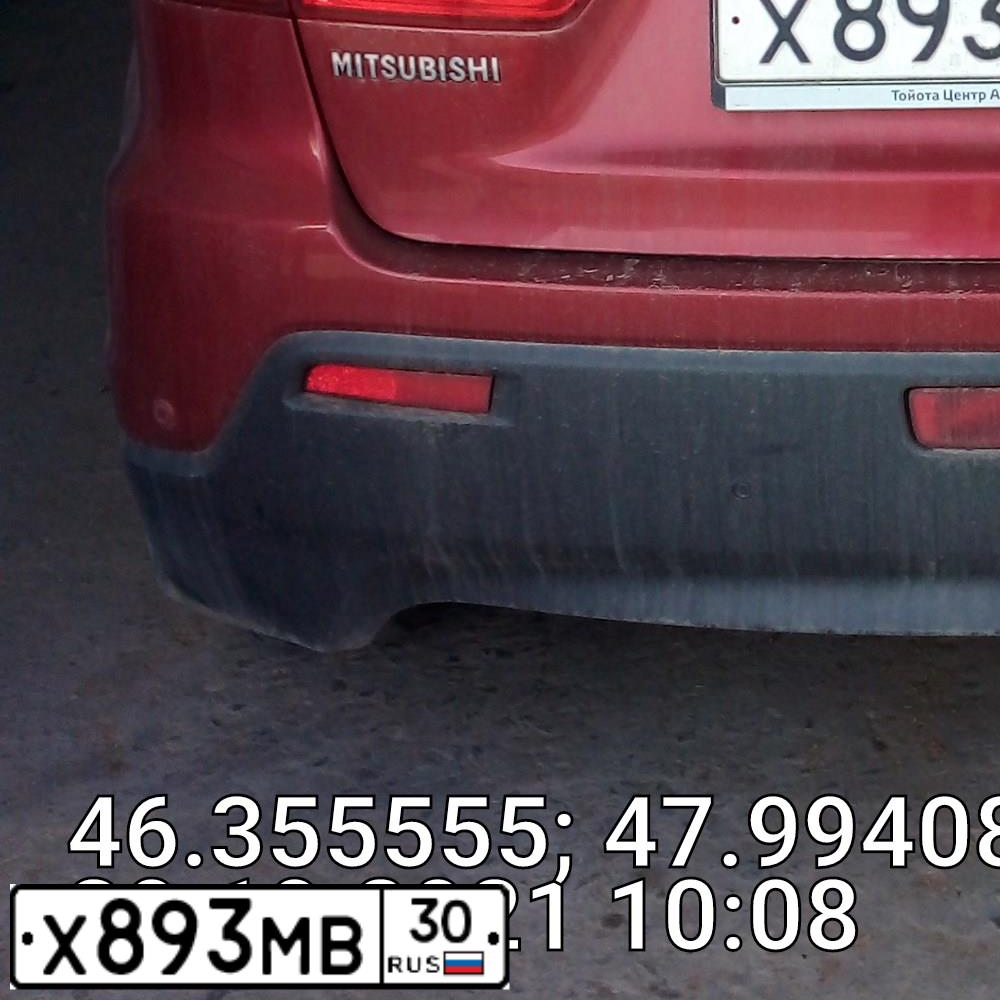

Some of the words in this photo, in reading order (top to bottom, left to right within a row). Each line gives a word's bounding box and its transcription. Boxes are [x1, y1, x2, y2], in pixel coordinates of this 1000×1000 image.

[330, 51, 501, 83] MITSUBISHI
[891, 88, 940, 102] Тойота
[942, 87, 987, 104] Центр
